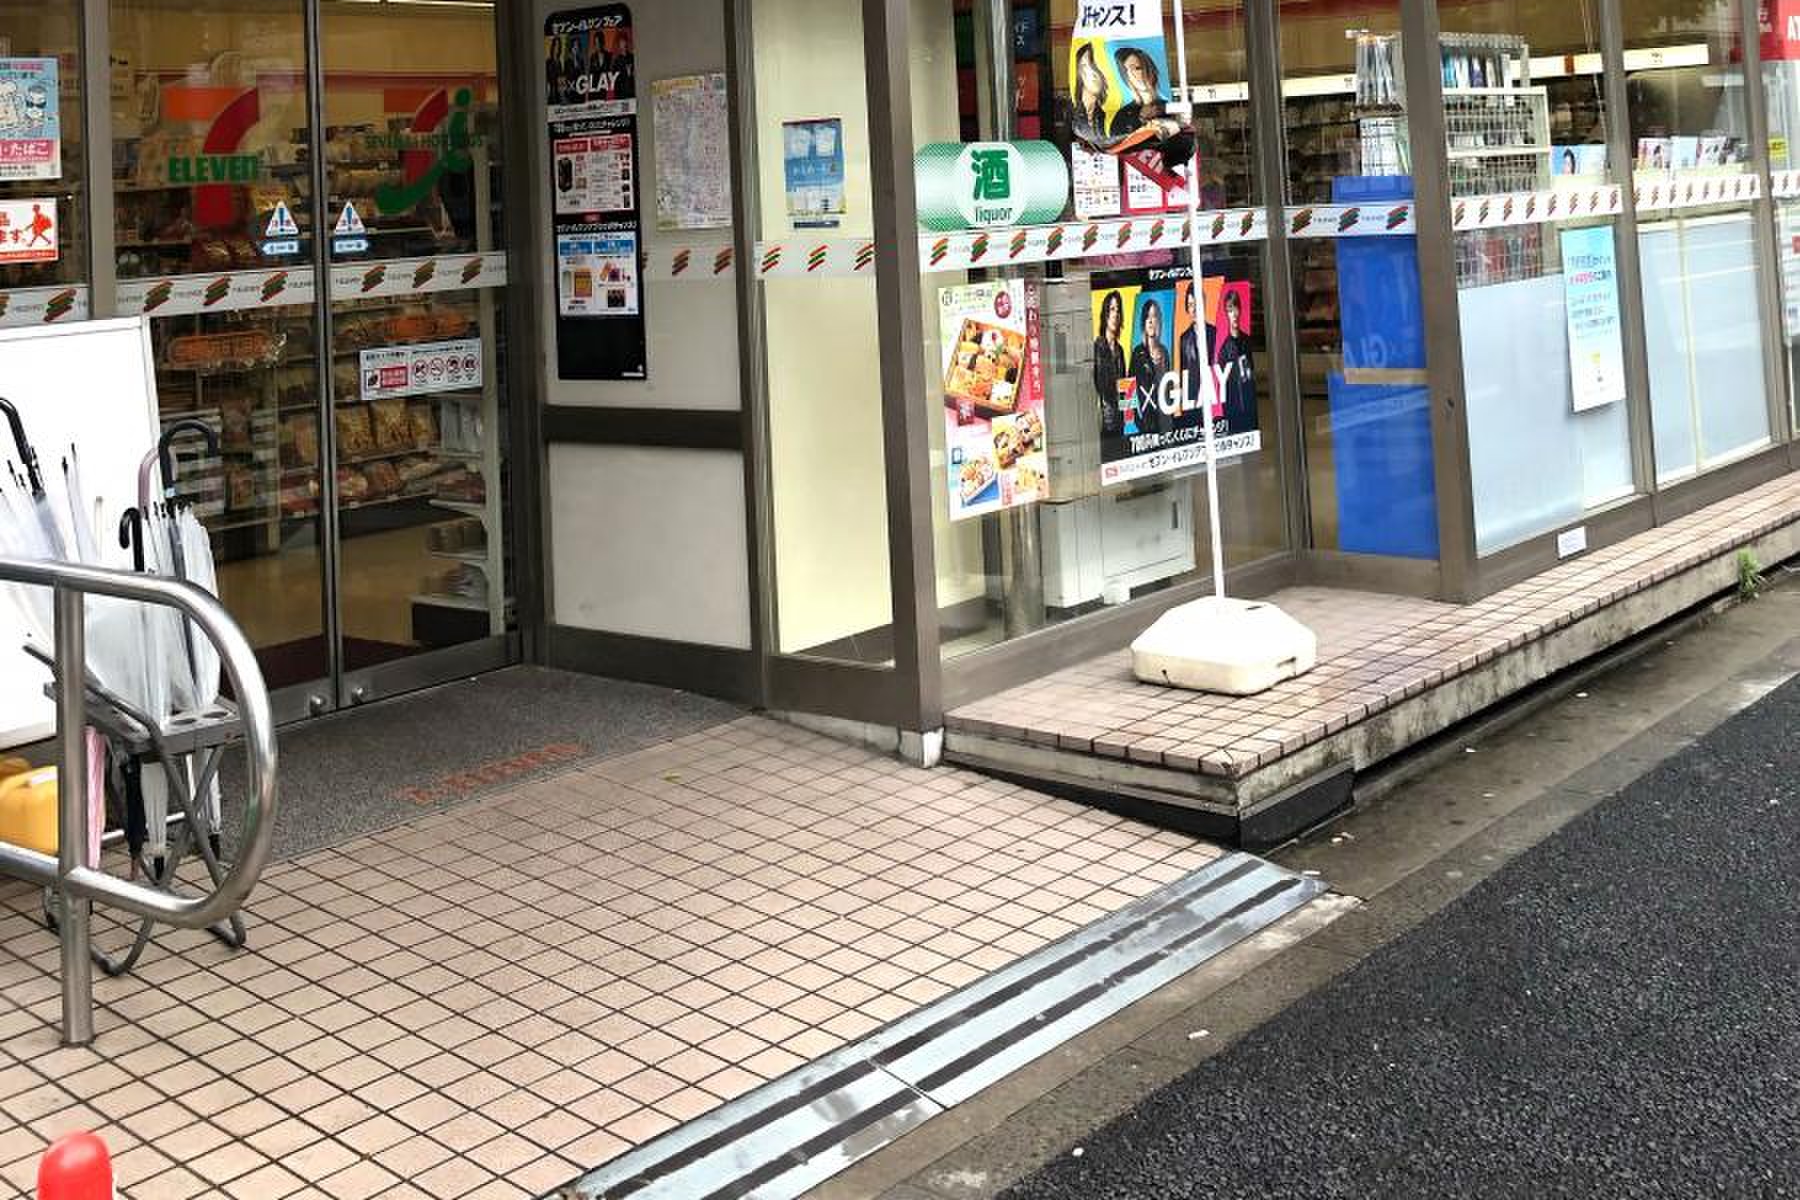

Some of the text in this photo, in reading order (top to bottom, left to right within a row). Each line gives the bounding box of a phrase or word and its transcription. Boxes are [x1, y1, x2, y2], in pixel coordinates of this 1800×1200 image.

[575, 70, 621, 96] GLAY
[970, 148, 1010, 201] 酒
[975, 205, 1013, 225] liquor
